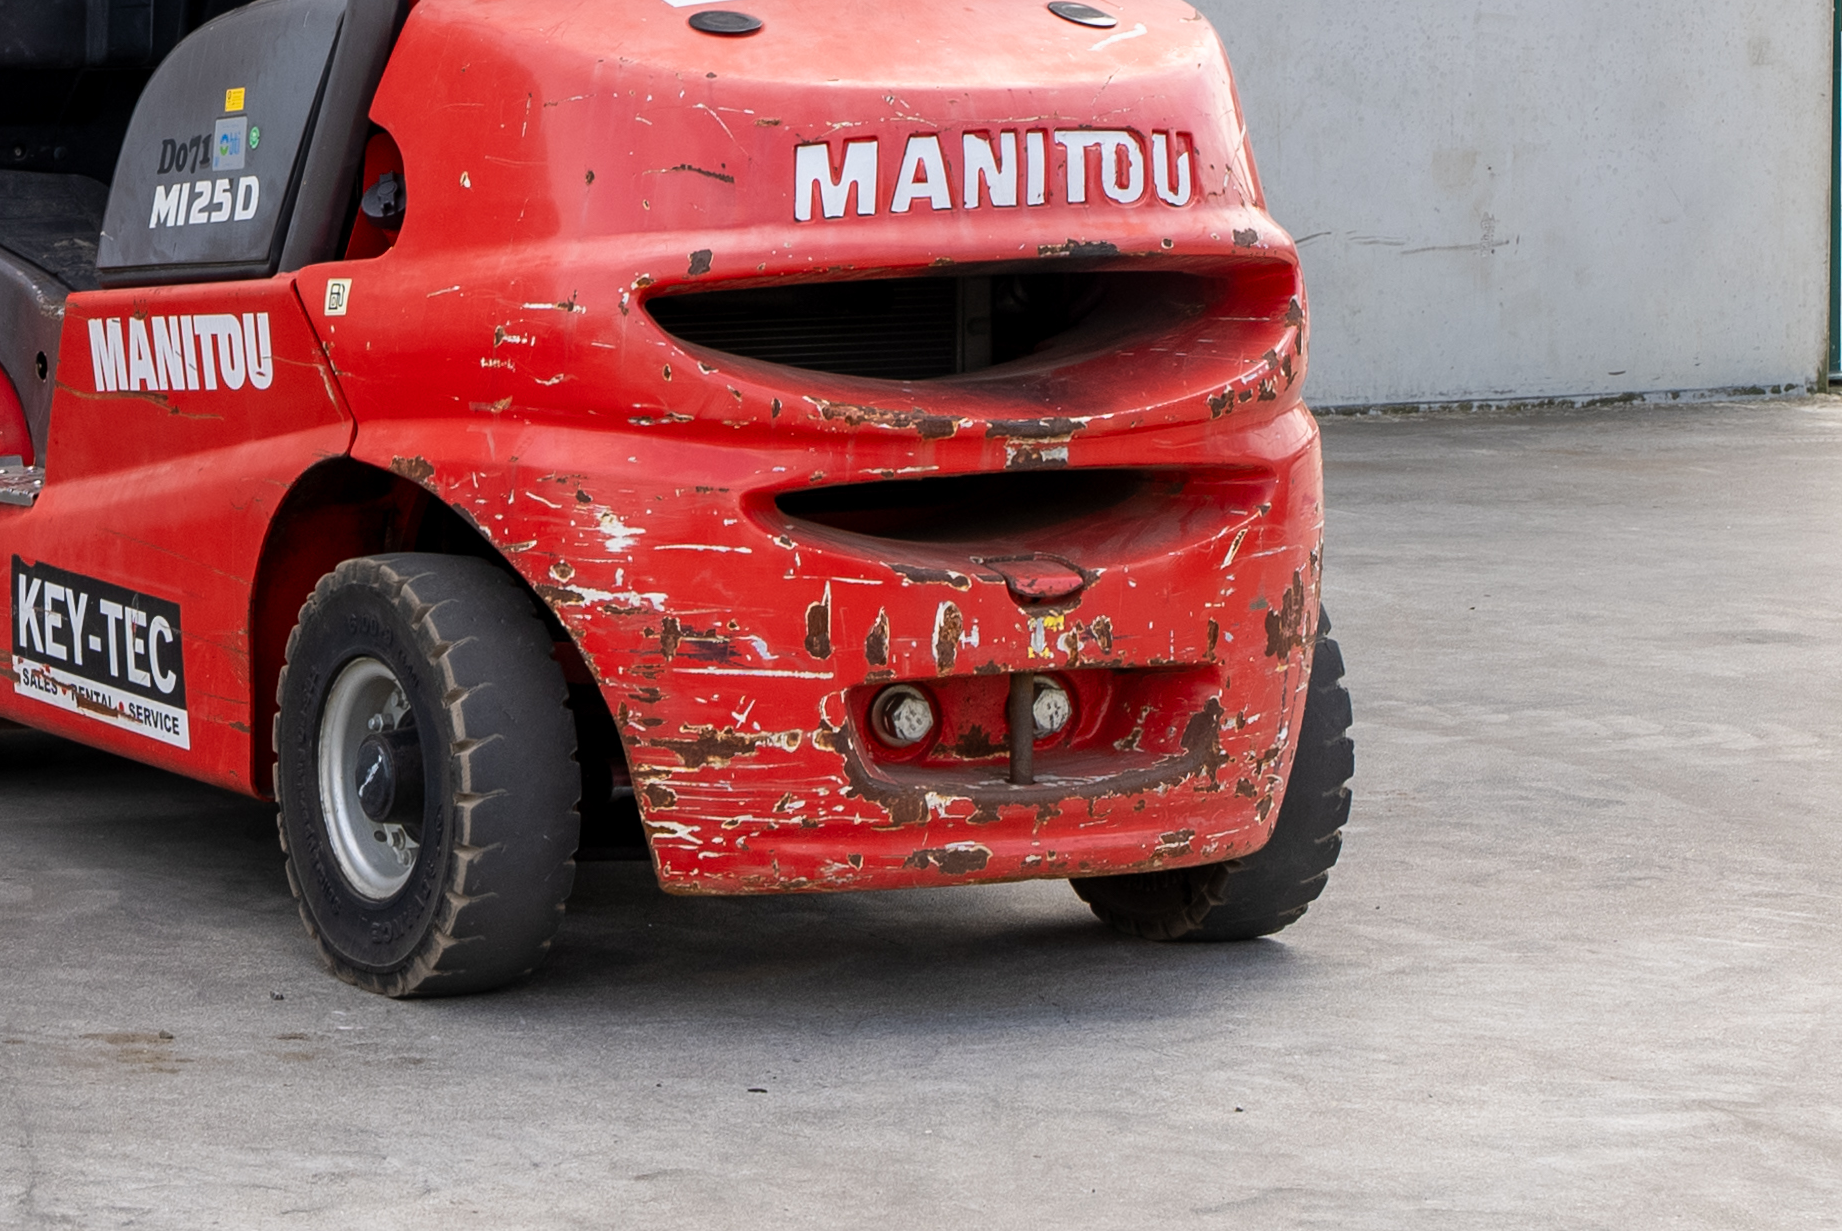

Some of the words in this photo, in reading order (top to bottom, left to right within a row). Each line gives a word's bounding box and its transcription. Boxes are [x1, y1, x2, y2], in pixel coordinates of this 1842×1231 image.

[149, 175, 260, 229] MI25D
[794, 130, 1191, 222] MANITOU
[87, 312, 274, 392] MANITOU
[18, 573, 177, 695] KEY-TEC
[22, 667, 58, 696] SALES
[128, 701, 180, 736] SERVICE
